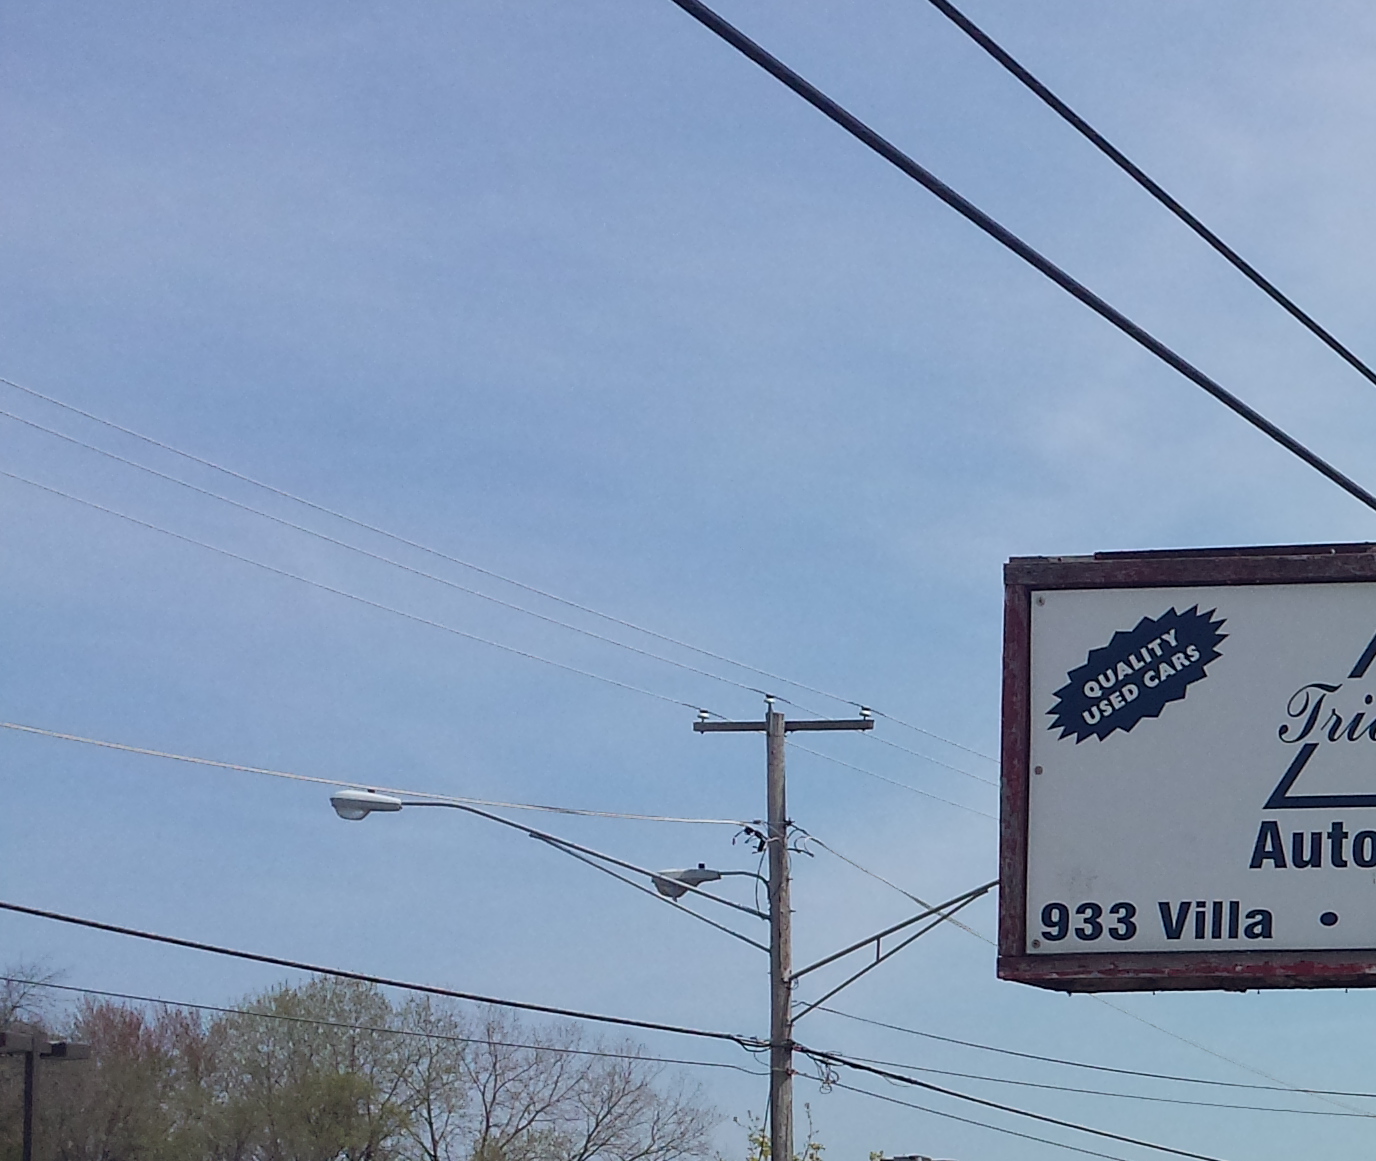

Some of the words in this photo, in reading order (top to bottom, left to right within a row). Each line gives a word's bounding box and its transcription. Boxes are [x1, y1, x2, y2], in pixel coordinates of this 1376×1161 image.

[1081, 683, 1140, 725] USED
[1143, 644, 1201, 688] CARS
[1083, 628, 1178, 698] QUALITY
[1040, 901, 1138, 941] 933
[1158, 900, 1274, 940] Villa
